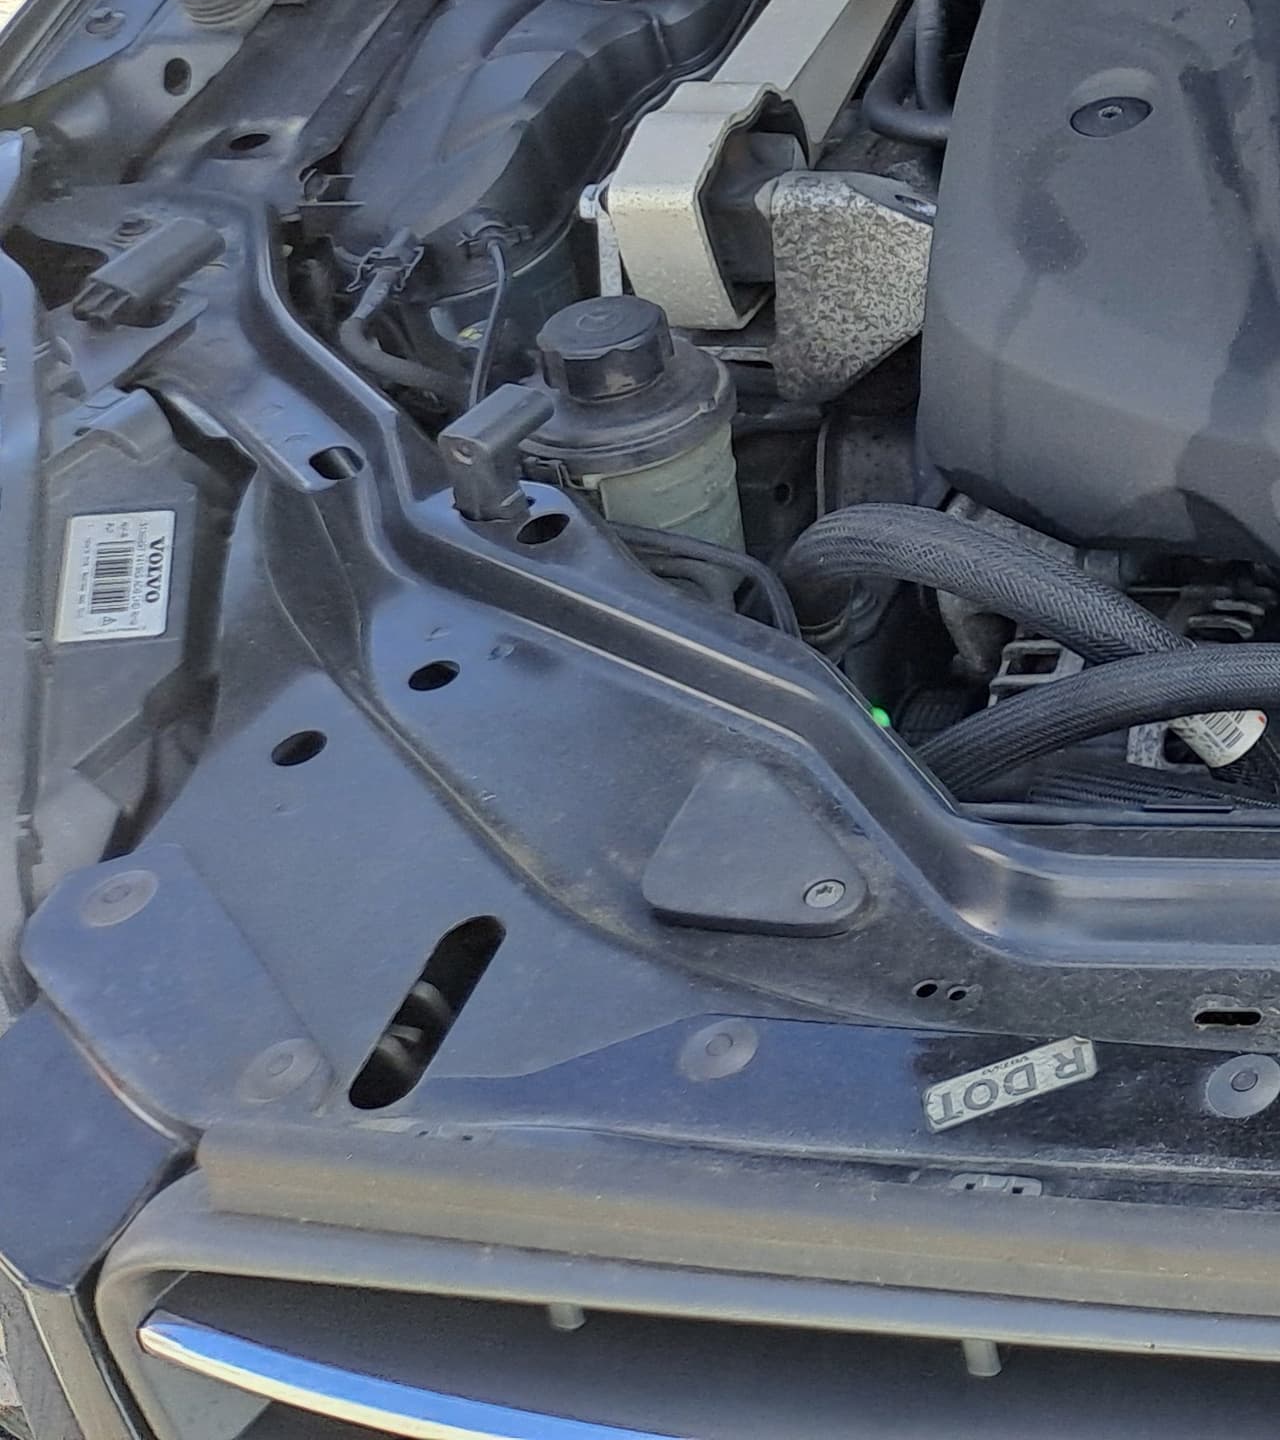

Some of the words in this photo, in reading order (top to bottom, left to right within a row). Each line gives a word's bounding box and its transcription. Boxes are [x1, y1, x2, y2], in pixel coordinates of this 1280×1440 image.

[145, 536, 166, 603] VOLVO
[929, 1062, 1038, 1125] DOT
[1052, 1046, 1087, 1079] R
